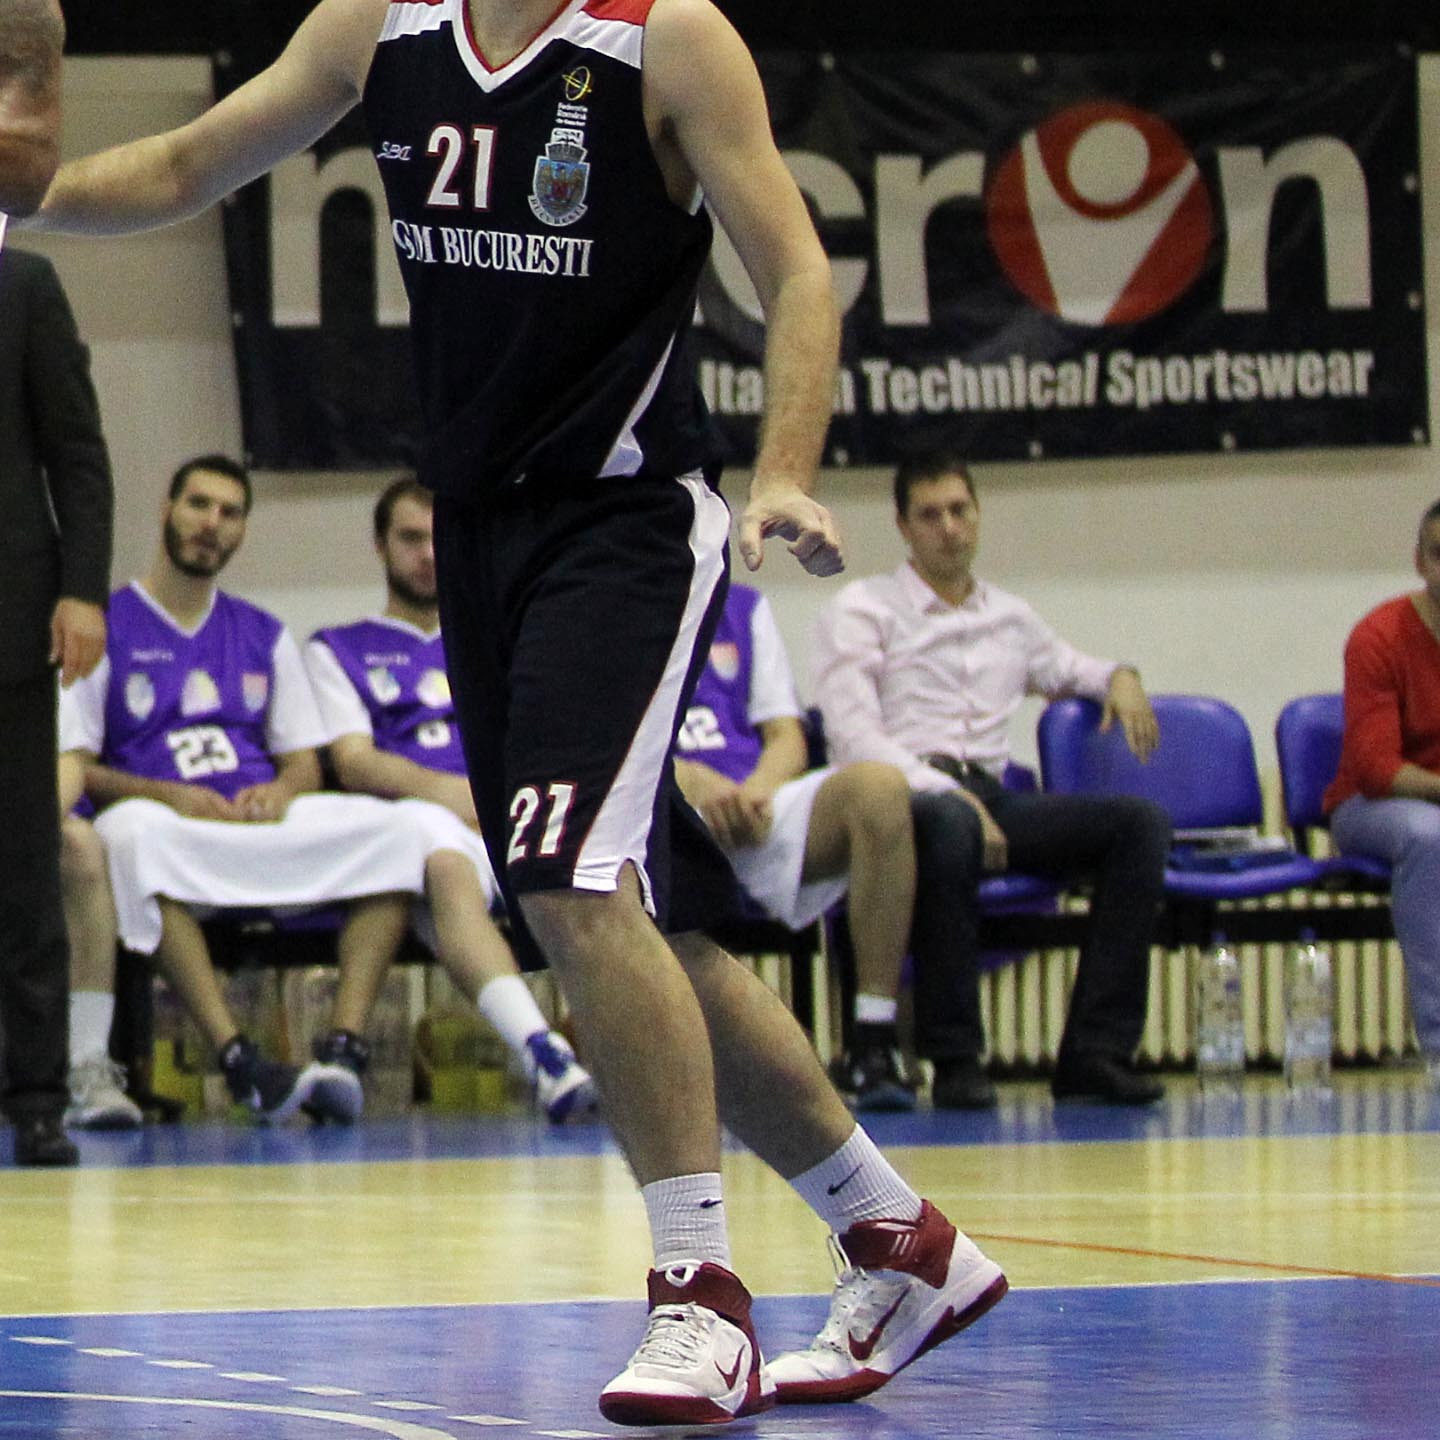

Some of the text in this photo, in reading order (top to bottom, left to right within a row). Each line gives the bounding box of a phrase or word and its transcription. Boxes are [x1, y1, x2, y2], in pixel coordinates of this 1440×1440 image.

[426, 121, 498, 211] 21
[439, 227, 595, 277] BUCURESTI
[863, 352, 1100, 414] Technical
[1106, 350, 1373, 409] Sportswear
[165, 724, 241, 781] 23
[506, 781, 575, 866] 21
